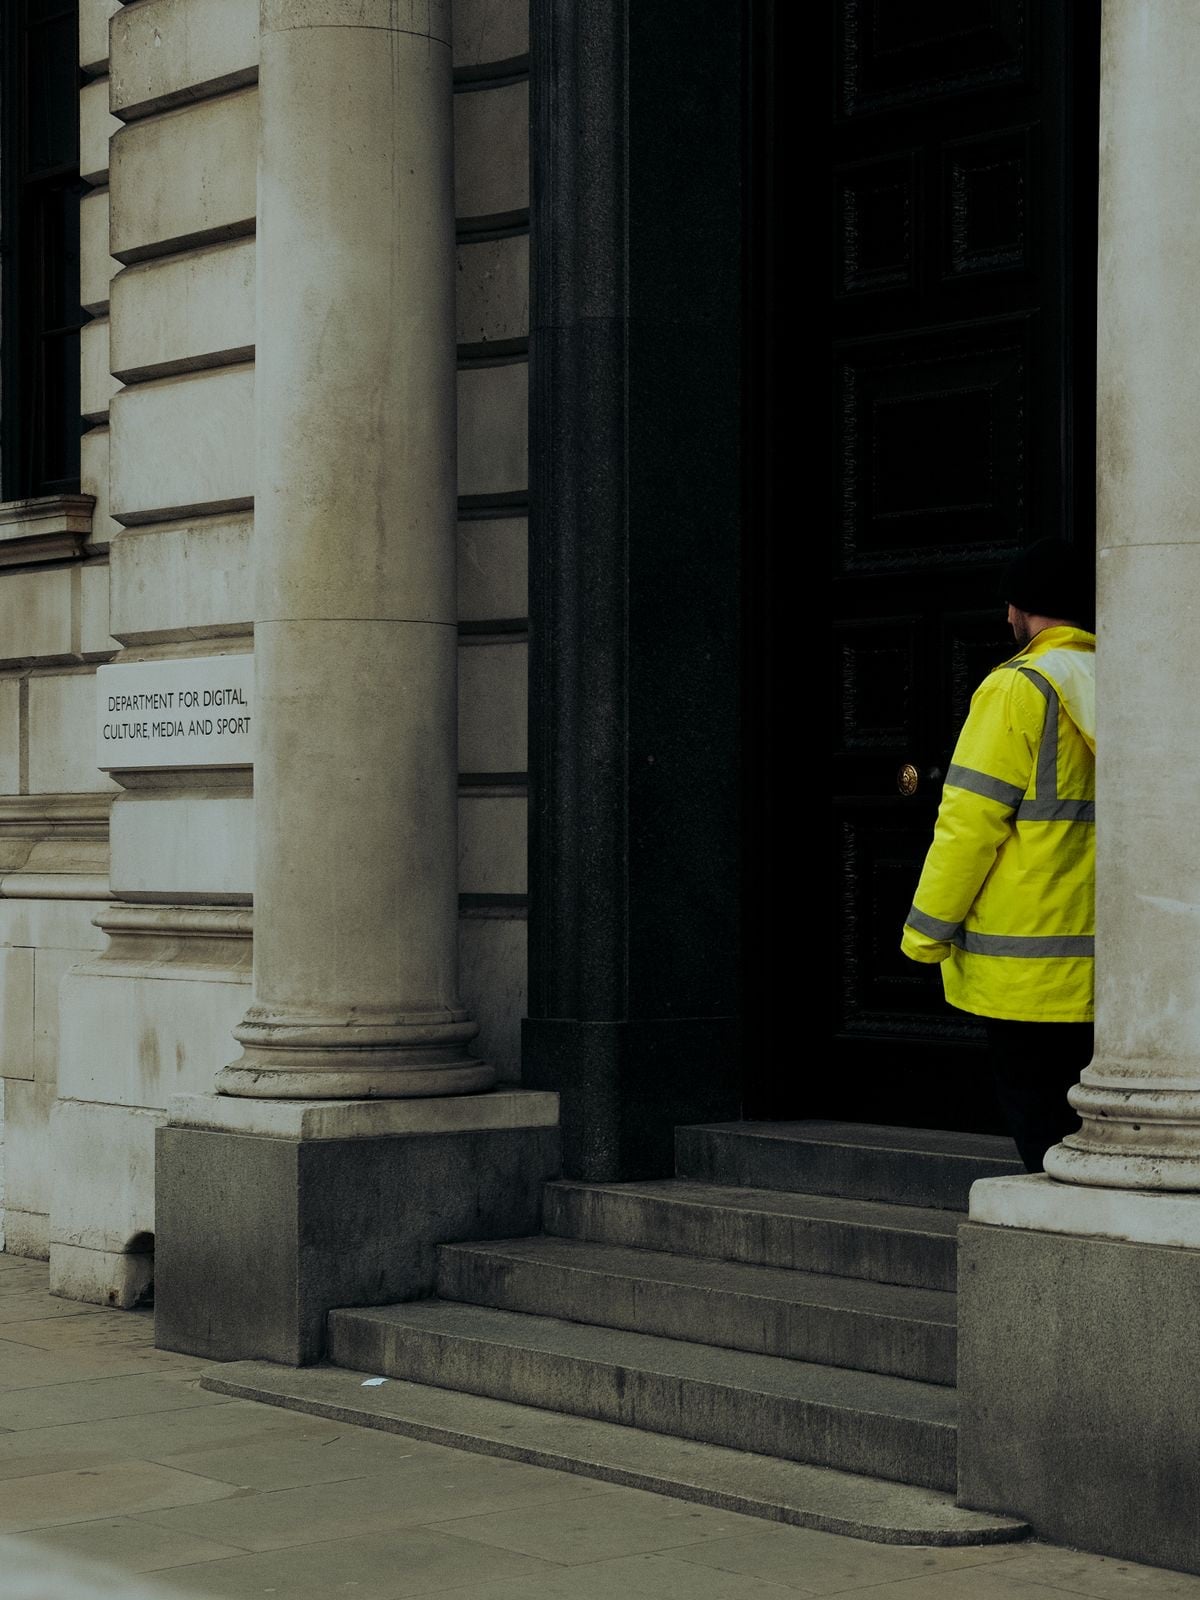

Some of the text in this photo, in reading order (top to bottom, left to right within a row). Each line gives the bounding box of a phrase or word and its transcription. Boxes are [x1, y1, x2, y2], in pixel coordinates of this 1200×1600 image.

[108, 688, 248, 711] DEPARTMENT FOR DIGITAL,
[103, 717, 251, 740] CULTURE, MEDIA AND SPORT
